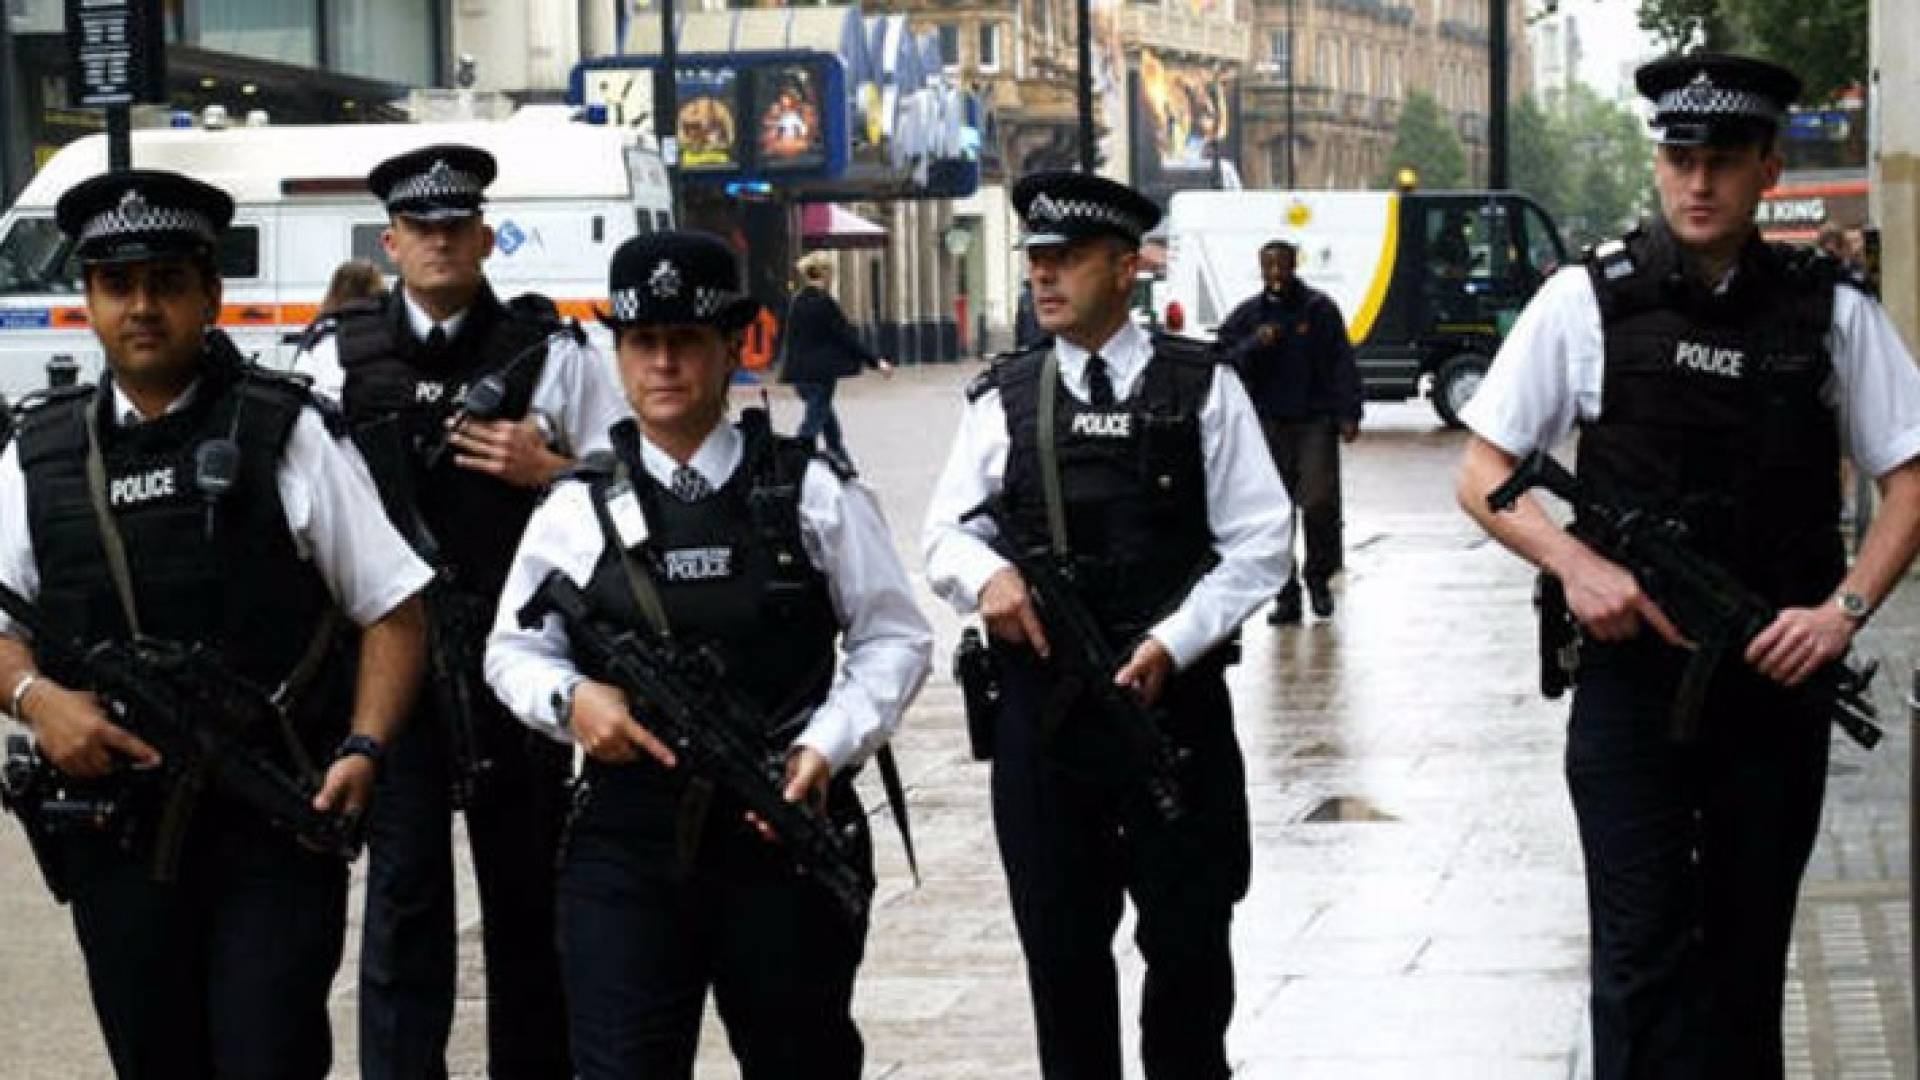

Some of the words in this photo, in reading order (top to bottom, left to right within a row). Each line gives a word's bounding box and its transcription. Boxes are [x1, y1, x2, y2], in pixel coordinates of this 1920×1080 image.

[1773, 197, 1824, 220] KING
[1677, 341, 1744, 378] POLICE
[1071, 413, 1130, 437] POLICE
[110, 467, 176, 506] POLICE
[666, 558, 730, 580] POLICE
